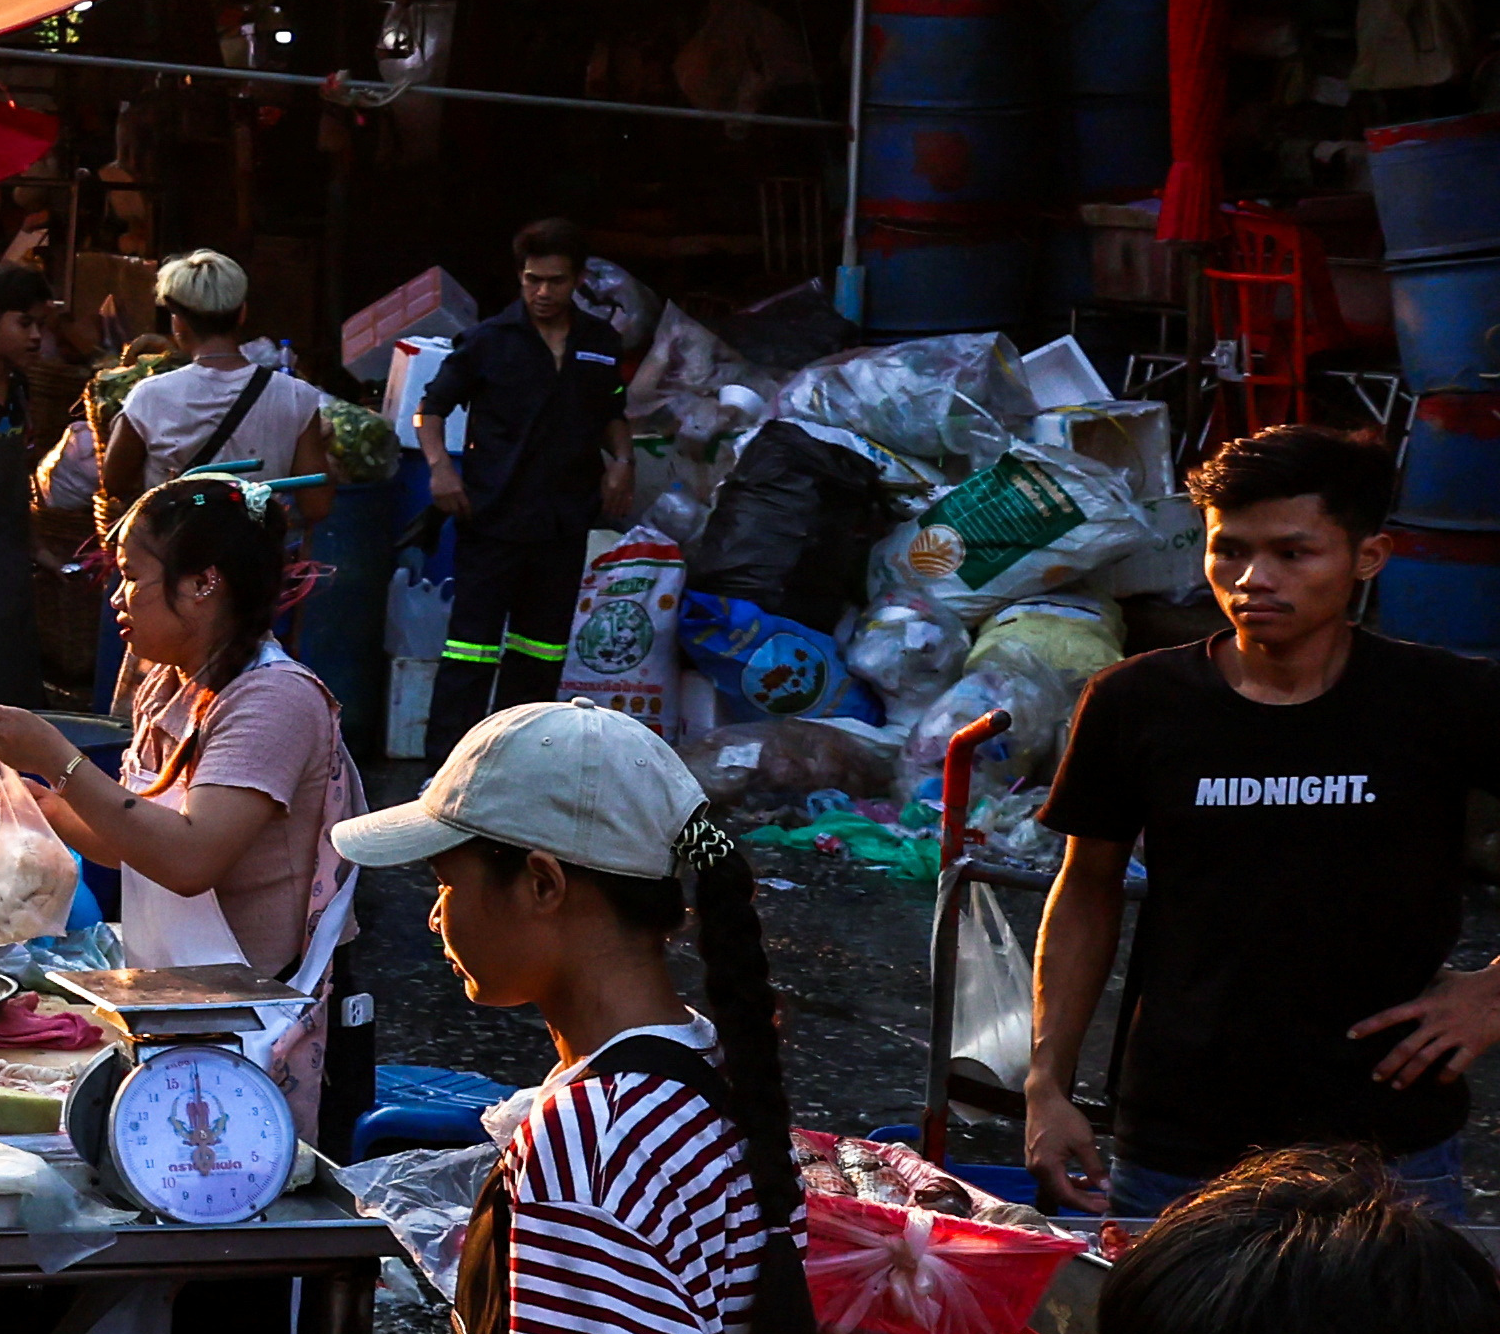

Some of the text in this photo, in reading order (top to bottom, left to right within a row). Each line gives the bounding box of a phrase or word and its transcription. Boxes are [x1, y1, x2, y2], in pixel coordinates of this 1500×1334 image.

[1195, 775, 1376, 807] MIDNIGHT.
[165, 1078, 179, 1090] 15
[252, 1107, 259, 1116] 3
[251, 1151, 259, 1163] 5
[162, 1177, 176, 1188] 10
